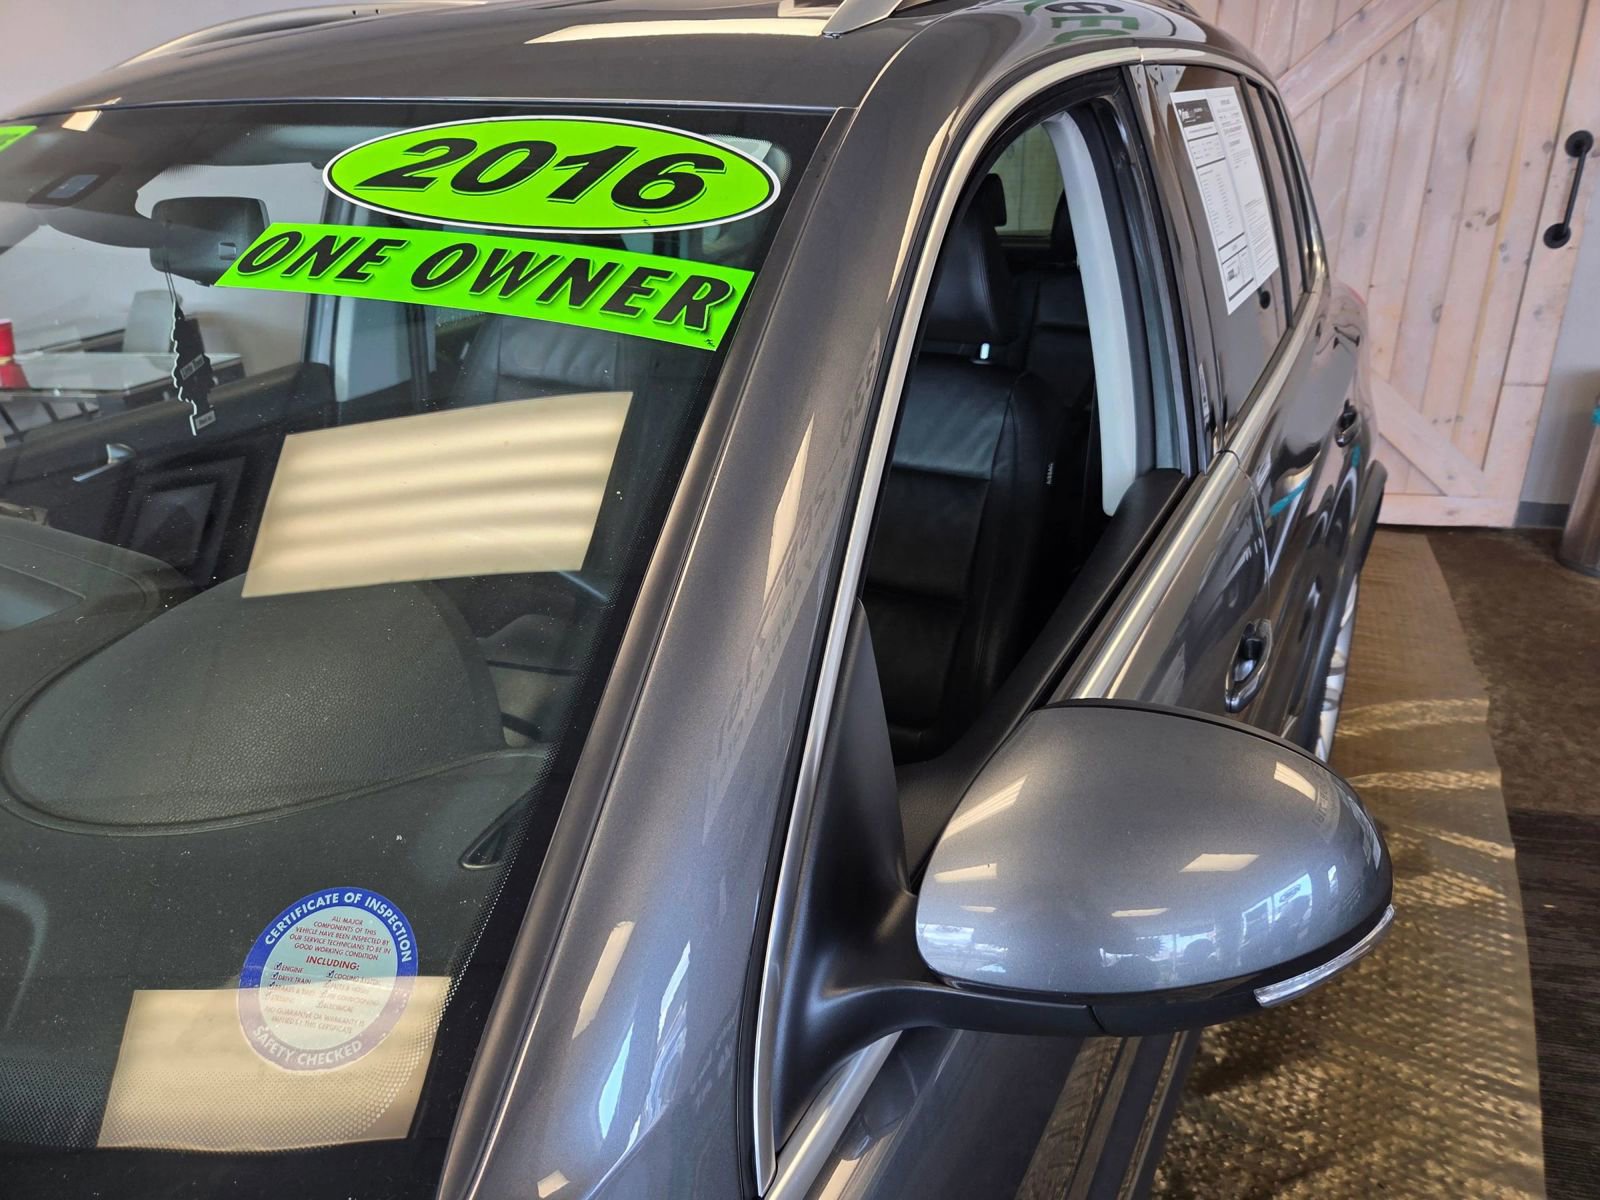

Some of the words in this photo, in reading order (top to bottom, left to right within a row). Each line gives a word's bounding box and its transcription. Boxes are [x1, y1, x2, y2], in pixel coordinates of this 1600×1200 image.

[355, 137, 728, 213] 2016
[235, 230, 407, 283] ONE
[409, 241, 735, 333] OWNER
[264, 892, 340, 945] CERTIFICATE
[343, 892, 363, 904] OF
[364, 896, 412, 963] INSPECTION
[313, 921, 353, 932] COMPONENTS
[343, 917, 363, 925] MAJOR
[289, 933, 303, 941] OUR
[303, 936, 326, 945] SERVICE
[327, 938, 365, 950] TECHNICIANS
[366, 944, 375, 952] TO
[296, 926, 318, 935] VEHICLE
[351, 934, 381, 945] INSPECTED
[294, 942, 313, 951] GOOD
[314, 946, 343, 956] WORKING
[344, 950, 379, 961] CONDITION
[281, 964, 304, 973] ENGINE
[306, 955, 360, 971] INCLUDING:
[277, 974, 294, 982] DRIVE
[294, 977, 311, 985] TRAIN
[252, 1025, 295, 1062] SAFETY
[297, 1039, 363, 1067] CHECKED
